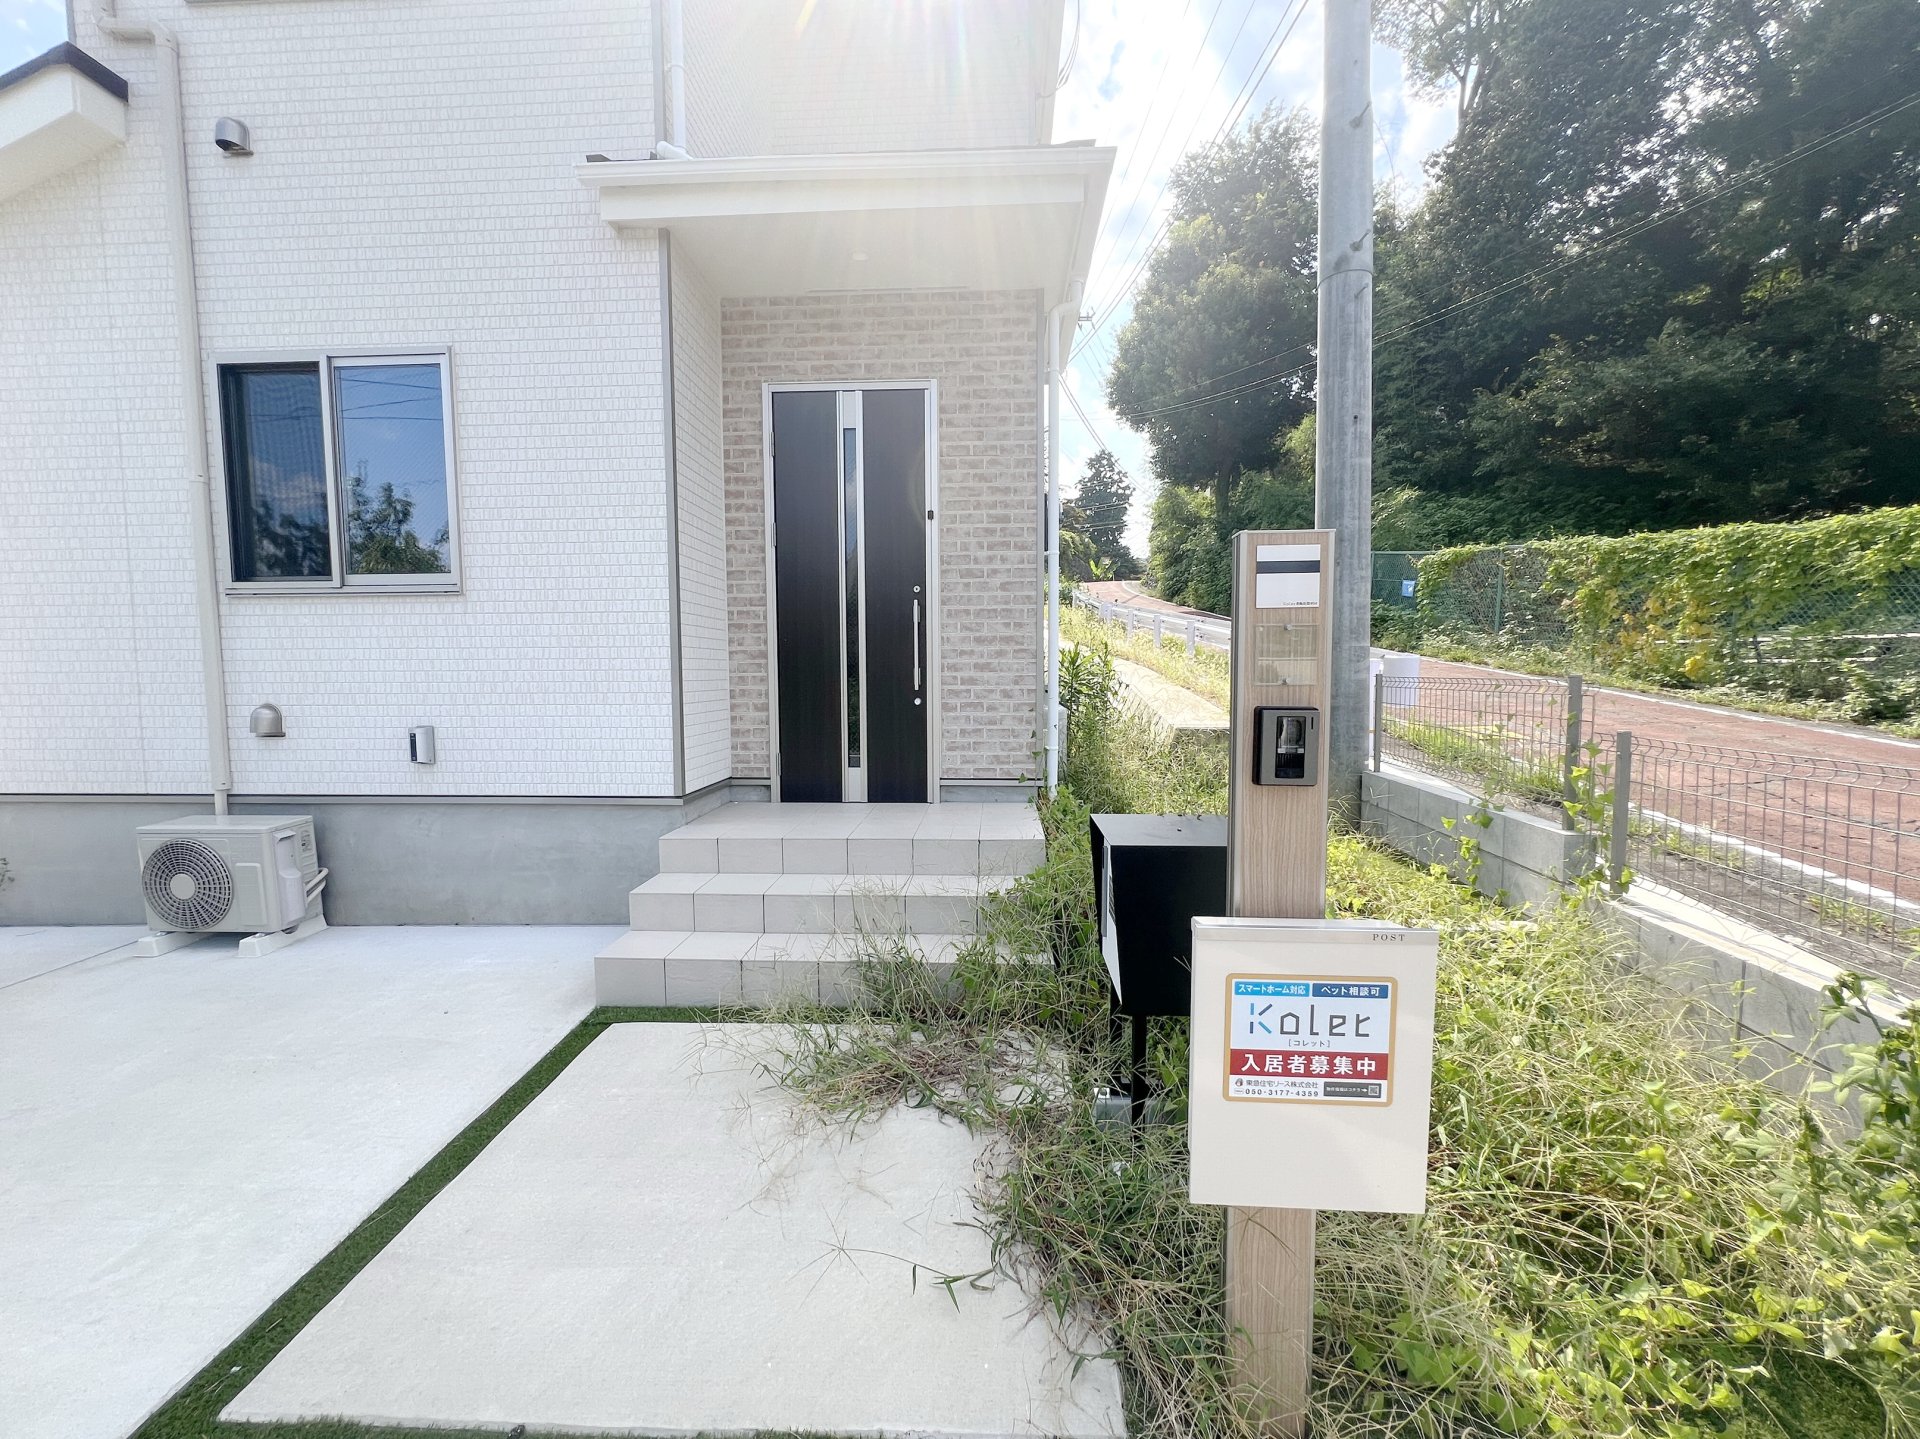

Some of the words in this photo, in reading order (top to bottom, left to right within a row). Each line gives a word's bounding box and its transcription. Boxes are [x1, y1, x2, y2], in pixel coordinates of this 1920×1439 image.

[1372, 933, 1406, 942] POST
[1238, 984, 1306, 994] スマートホーム対応
[1321, 986, 1381, 997] ペット相談可
[1249, 1003, 1371, 1037] Kolet
[1241, 1053, 1376, 1076] 入居者募集中
